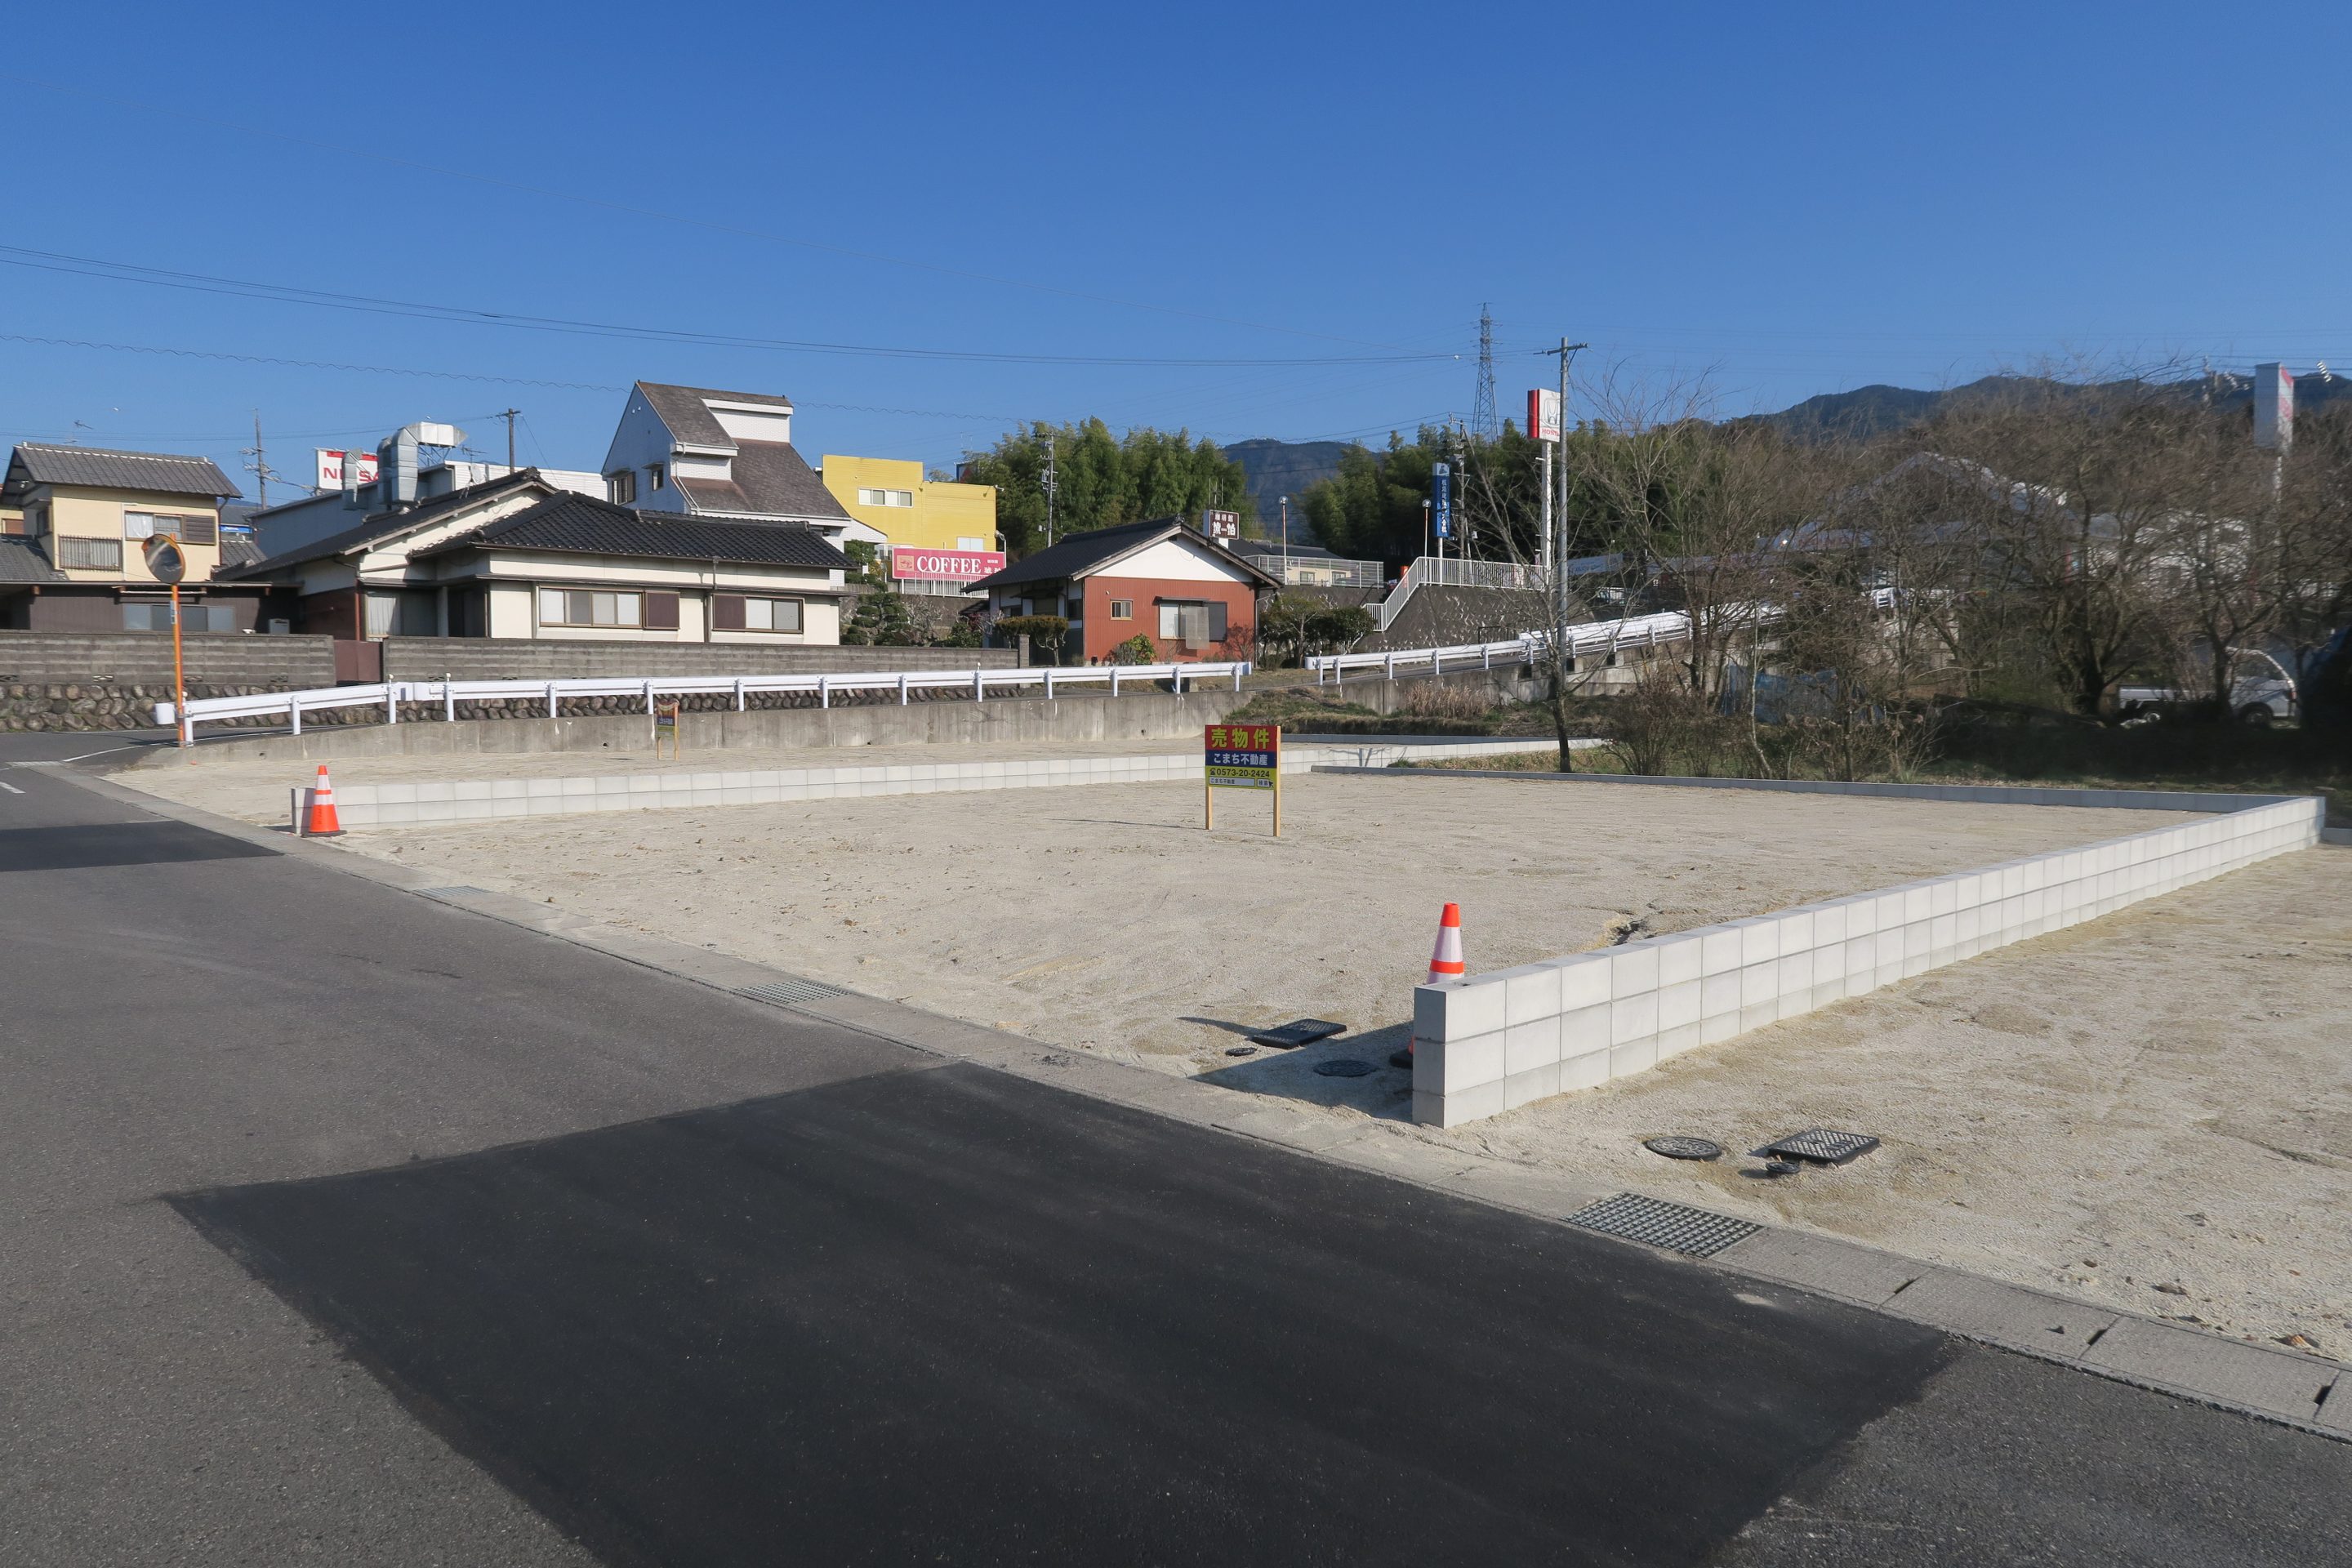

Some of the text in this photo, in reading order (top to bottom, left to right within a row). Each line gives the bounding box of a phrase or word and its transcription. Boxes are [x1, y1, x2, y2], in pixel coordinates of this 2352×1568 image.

[1542, 428, 1559, 437] HOND
[323, 467, 380, 482] NIS
[916, 555, 981, 574] COFFEE
[1211, 728, 1270, 750] 売物件
[1214, 753, 1268, 766] こまち不動産
[1216, 768, 1270, 777] 0573-20-2424
